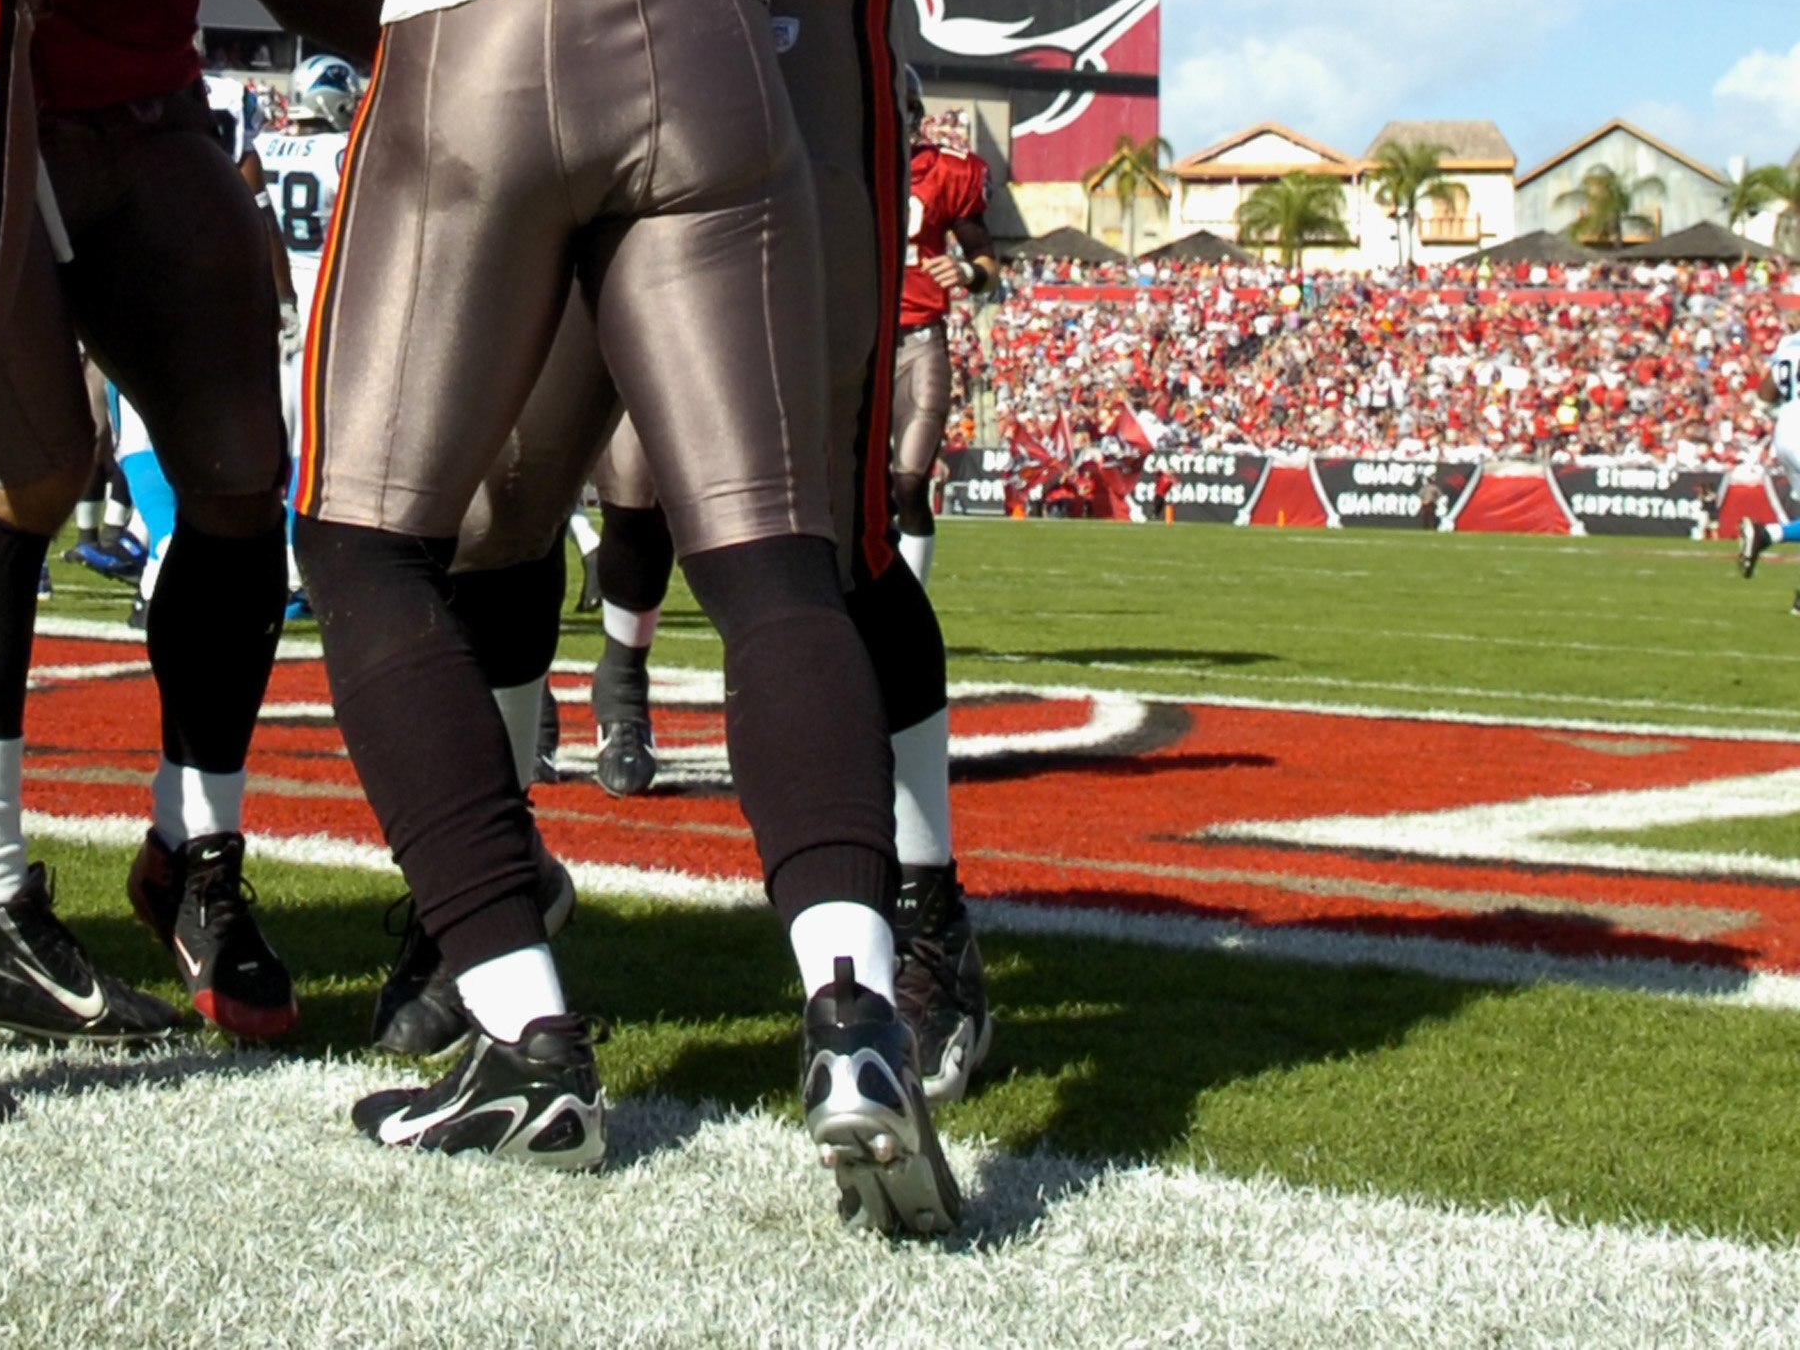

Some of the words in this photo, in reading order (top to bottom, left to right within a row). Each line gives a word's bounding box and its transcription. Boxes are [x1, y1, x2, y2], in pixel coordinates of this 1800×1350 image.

[1143, 454, 1236, 476] CARTER'S
[1134, 482, 1246, 506] CRSADERS
[1337, 491, 1449, 518] WARRIOS
[1571, 494, 1702, 521] SUPERSTARS
